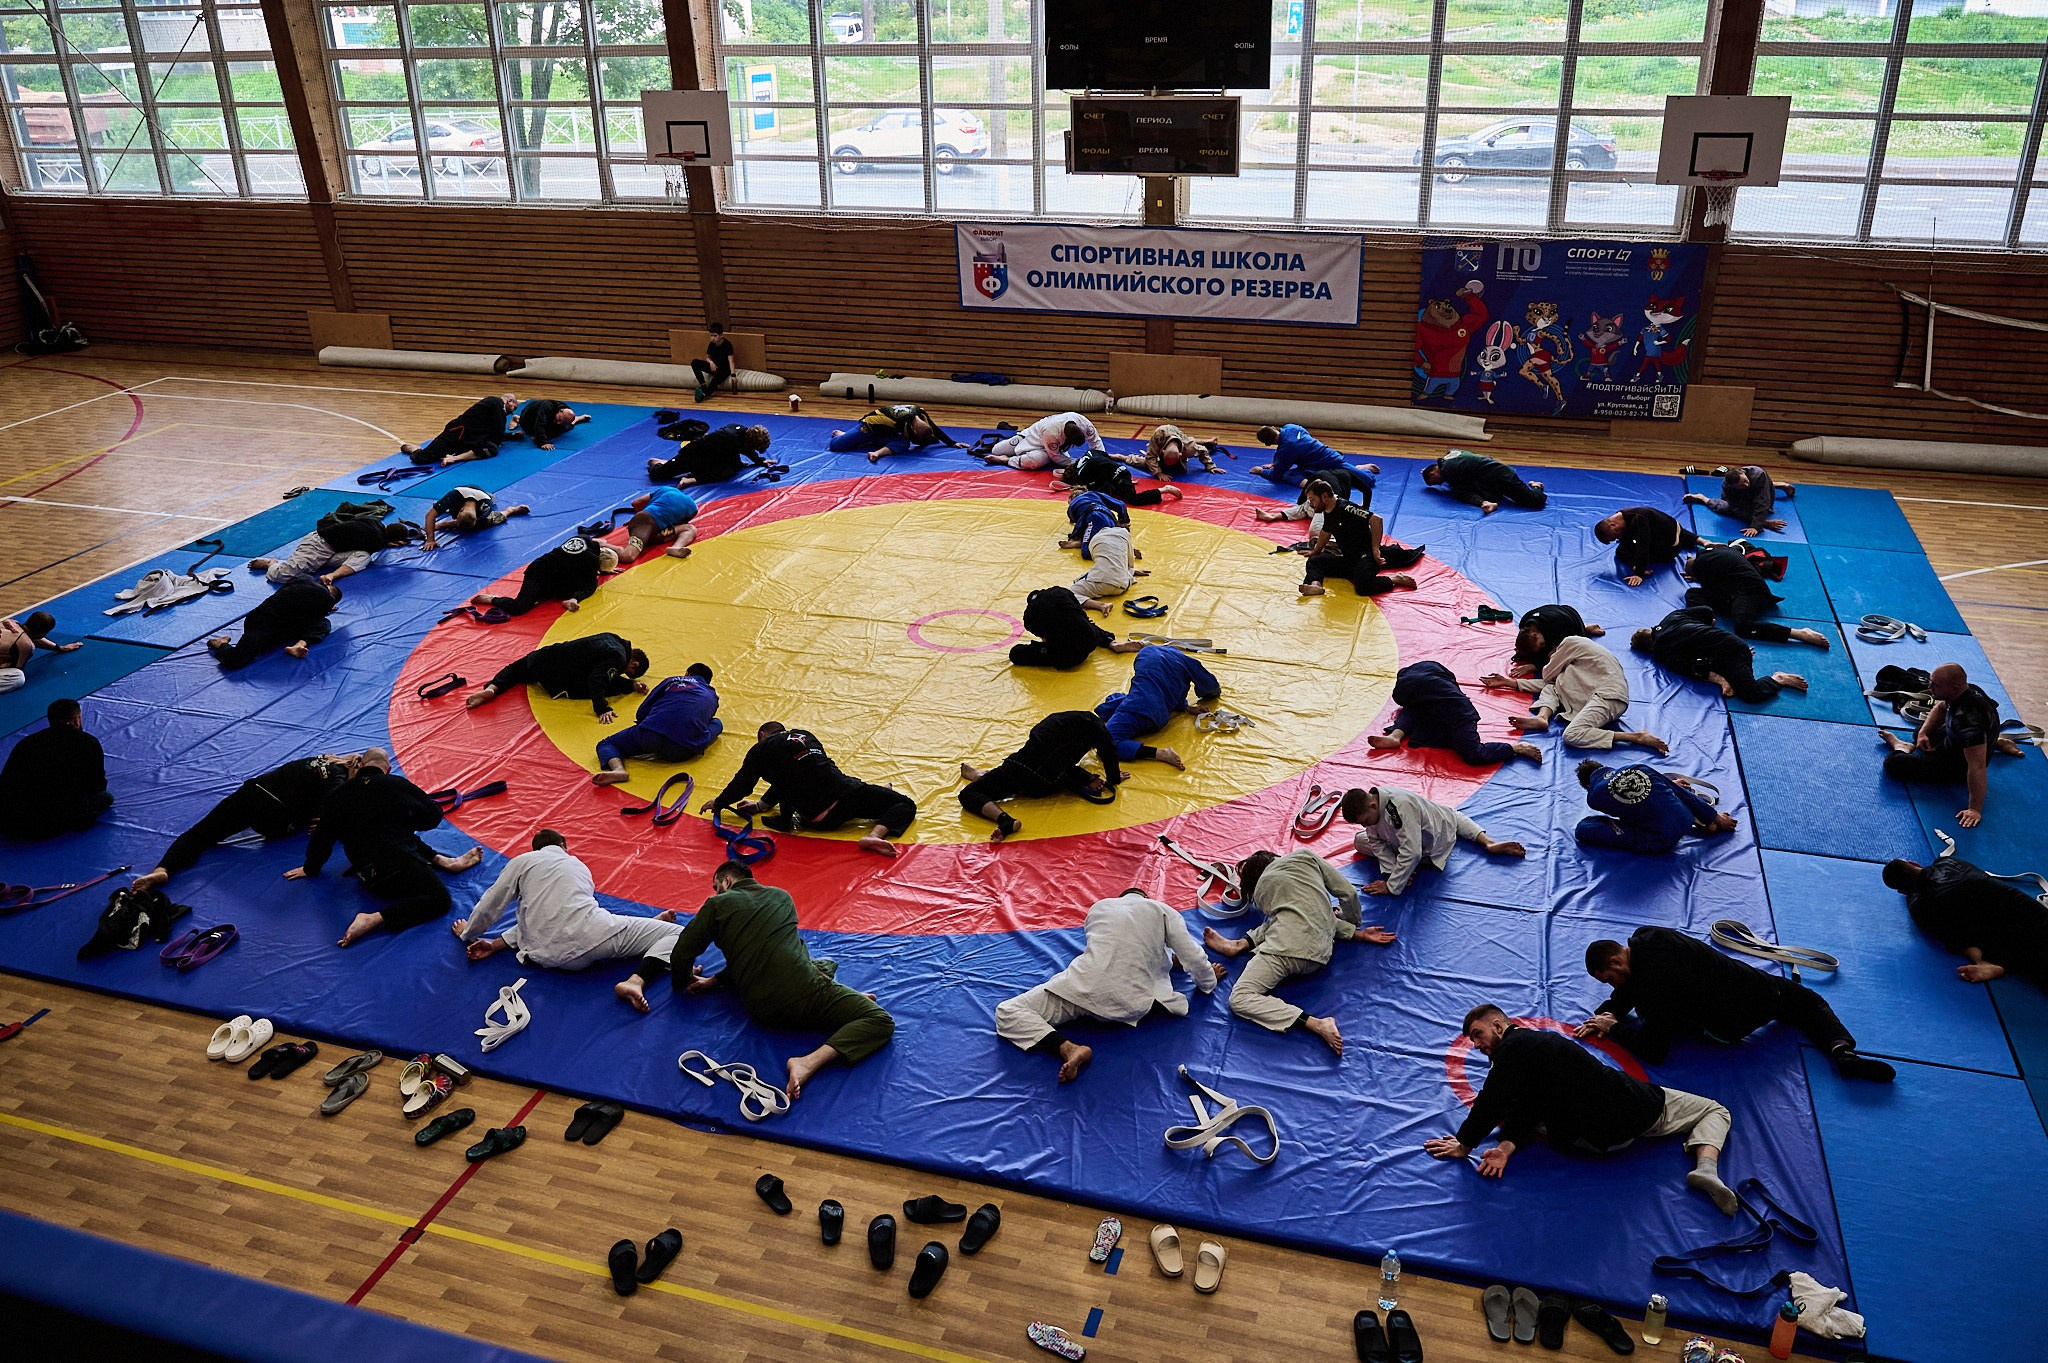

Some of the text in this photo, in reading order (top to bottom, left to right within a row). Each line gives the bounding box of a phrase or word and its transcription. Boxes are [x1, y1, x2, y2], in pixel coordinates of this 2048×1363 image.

[1145, 36, 1168, 44] ВРЕМЯ
[1059, 43, 1079, 51] ФОЛЫ
[1233, 42, 1255, 50] ФОЛЫ
[1136, 116, 1173, 125] ПЕРИОД
[1202, 113, 1226, 121] СЧЕТ
[1082, 147, 1110, 155] ФОЛЫ
[1138, 146, 1169, 155] ВРЕМЯ
[1199, 148, 1229, 157] ФОЛЫ
[972, 229, 1004, 238] ФАВОРИТ
[1567, 247, 1615, 260] СПОРТ
[1050, 244, 1306, 272] СПОРТИВНАЯ ШКОЛА
[1026, 270, 1333, 300] ОЛИМПИЙСКОГО РЕЗЕРВА
[1627, 394, 1651, 402] Выборг
[1593, 409, 1648, 417] 8-950-025-82-74
